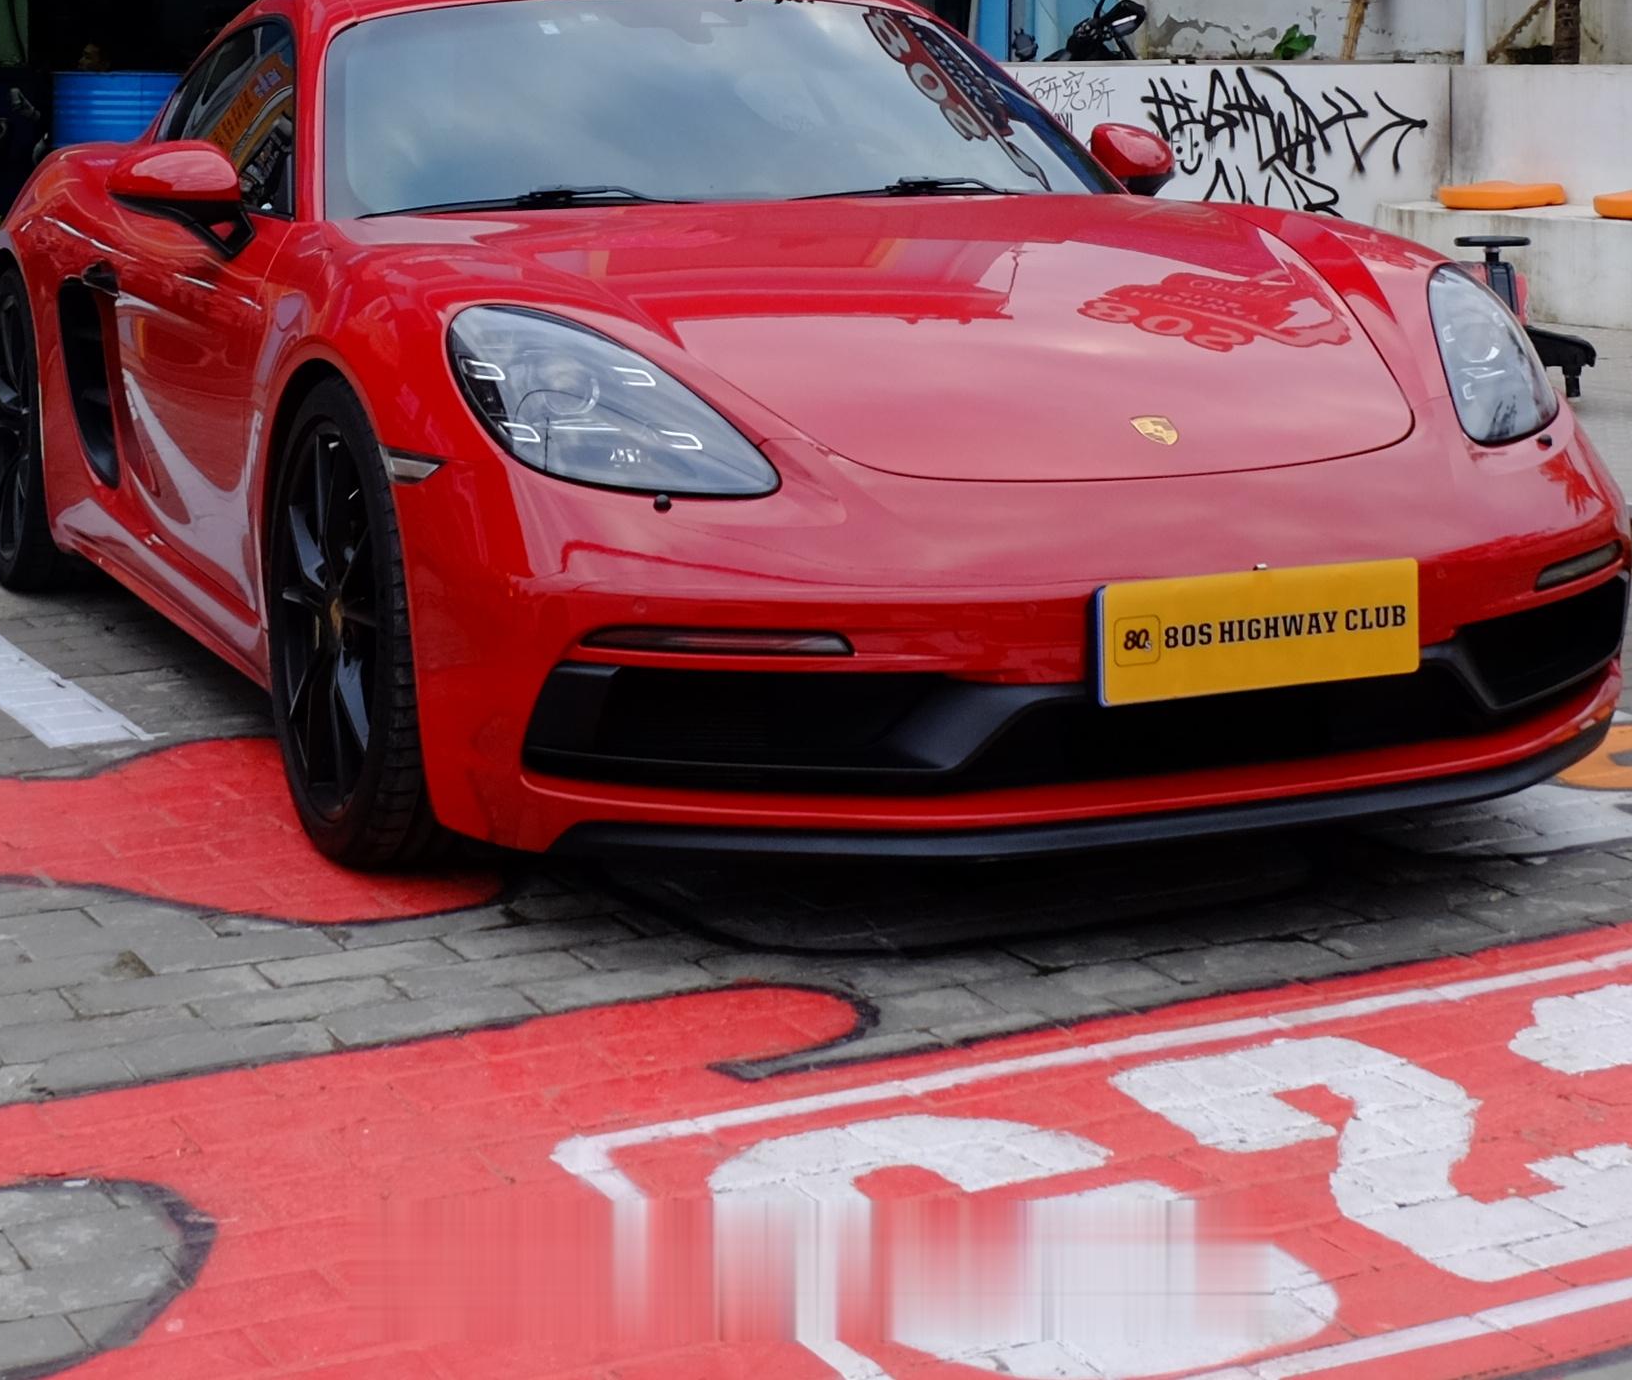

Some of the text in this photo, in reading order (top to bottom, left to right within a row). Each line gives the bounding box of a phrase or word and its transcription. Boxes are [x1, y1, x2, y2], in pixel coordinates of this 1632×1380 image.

[1163, 623, 1213, 650] 80S
[1218, 609, 1339, 645] HIGHWAY
[1343, 603, 1407, 632] CLUB
